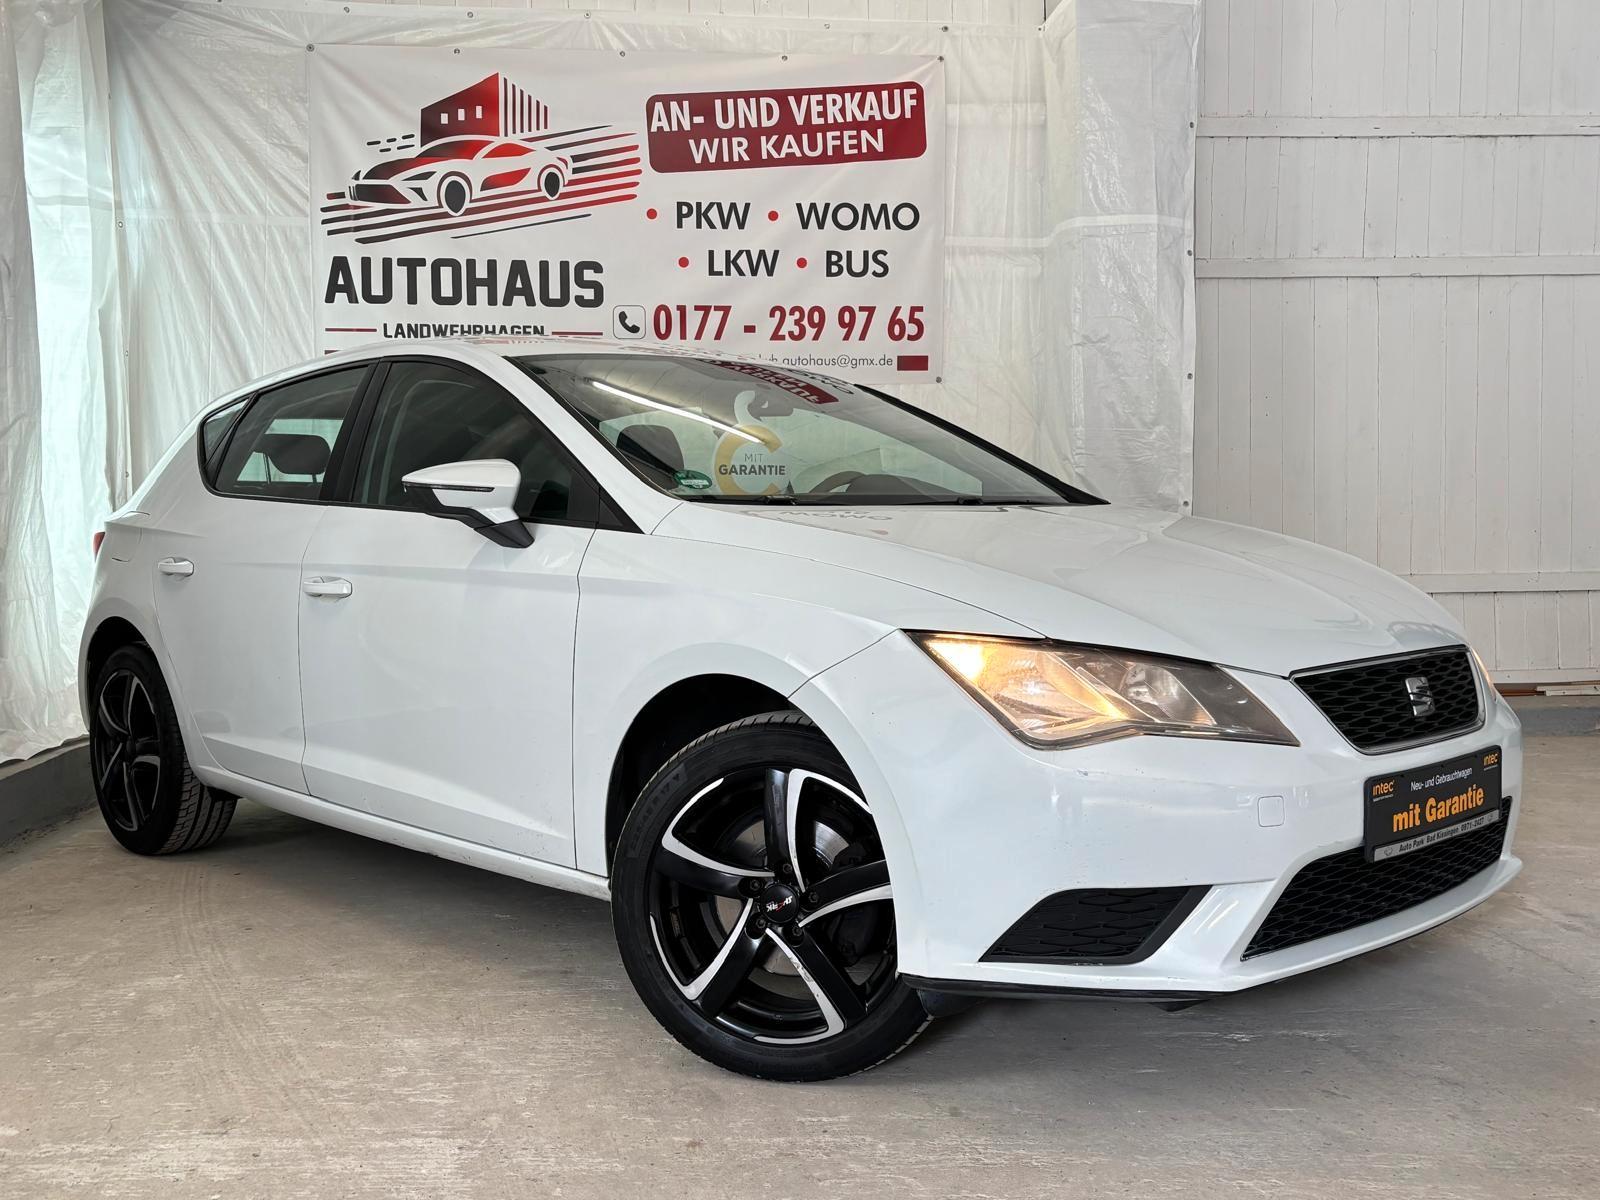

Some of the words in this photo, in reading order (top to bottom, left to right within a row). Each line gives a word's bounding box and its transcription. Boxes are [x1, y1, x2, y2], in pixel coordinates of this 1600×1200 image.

[650, 101, 705, 133] AN-
[714, 97, 780, 130] UND
[787, 88, 918, 126] VERKAUF
[688, 136, 750, 165] WIR
[760, 128, 885, 160] KAUFEN
[676, 201, 751, 230] PKW
[796, 202, 921, 231] WOMO
[707, 249, 780, 277] LKW
[825, 250, 889, 278] BUS
[325, 256, 604, 308] AUTOHAUS
[653, 304, 733, 341] 0177
[768, 305, 826, 342] 239
[837, 305, 877, 342] 97
[887, 305, 925, 342] 65
[719, 464, 786, 475] GARANTIE
[744, 453, 763, 462] MIT
[1484, 753, 1498, 766] intec
[1372, 780, 1394, 796] intec
[1410, 781, 1424, 792] Neu-
[1425, 777, 1435, 788] und
[1435, 767, 1473, 785] Gebrauchtwagen
[1393, 803, 1421, 832] mit
[1426, 785, 1485, 822] Garantie
[1399, 843, 1412, 852] Auto
[1426, 834, 1436, 843] Bad
